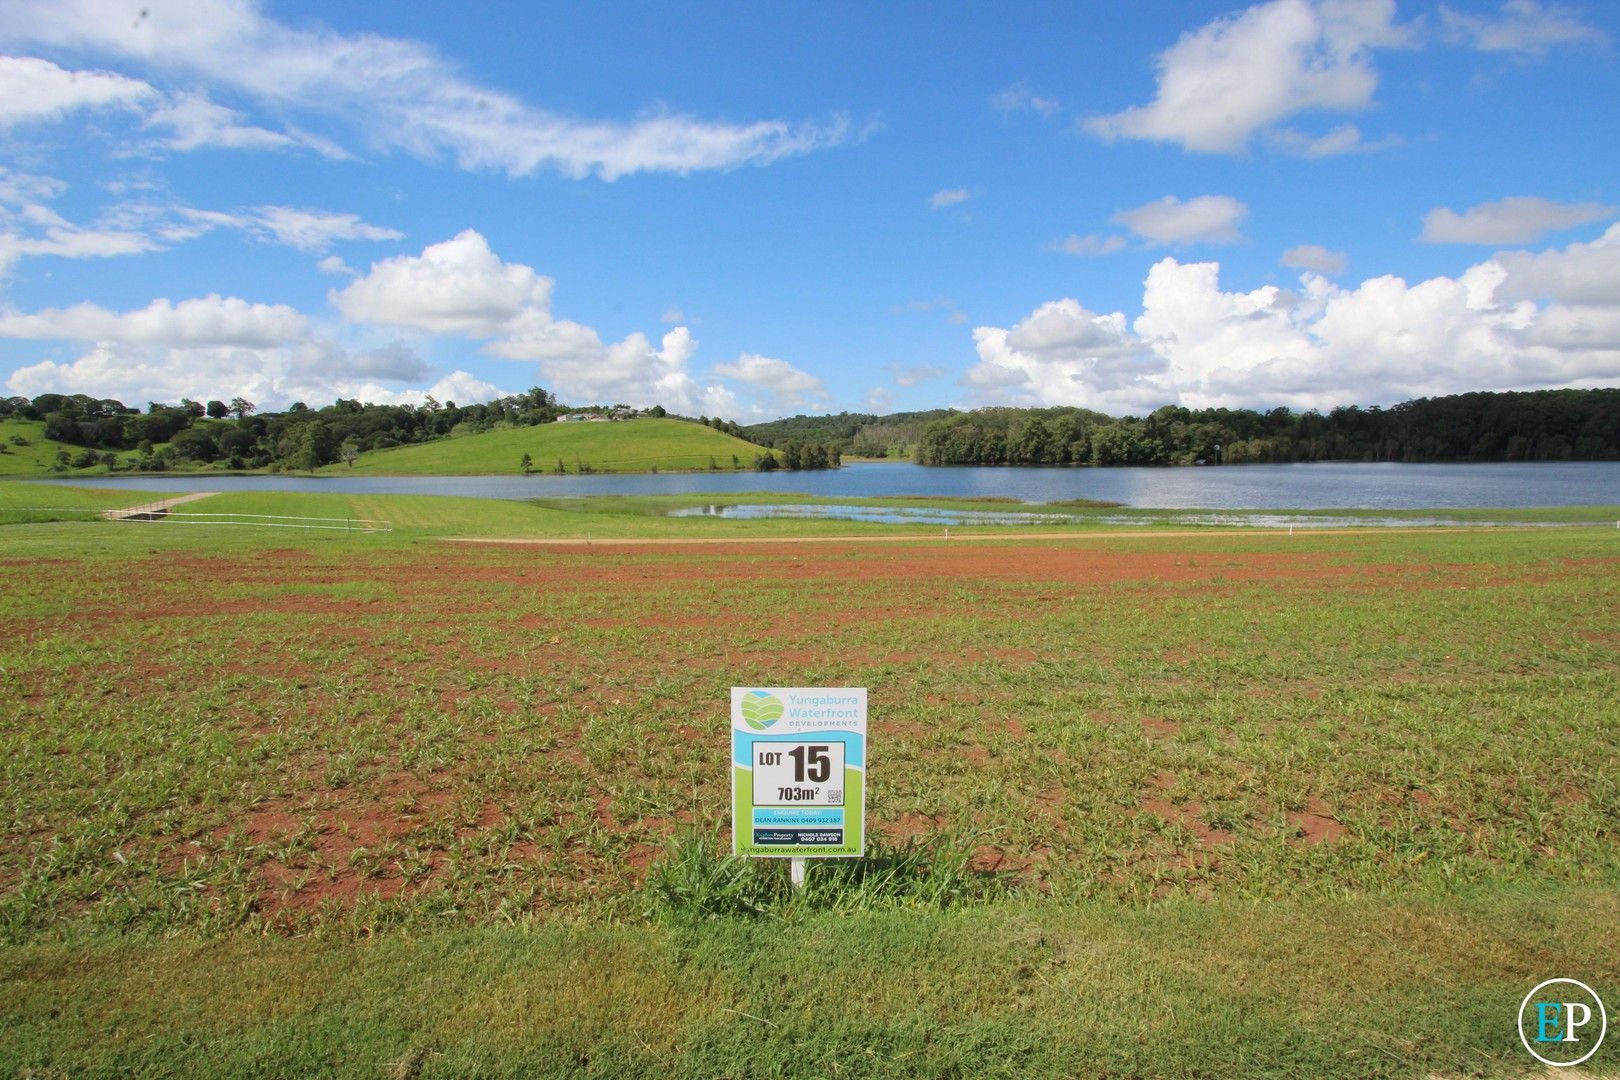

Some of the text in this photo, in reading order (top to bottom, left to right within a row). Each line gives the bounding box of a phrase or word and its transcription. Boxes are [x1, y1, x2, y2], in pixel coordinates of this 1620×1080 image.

[789, 694, 858, 706] Yungaburra
[789, 709, 858, 718] Waterfront
[760, 745, 831, 783] LOT 15
[741, 846, 856, 854] yngaburrawaterfront.com.au
